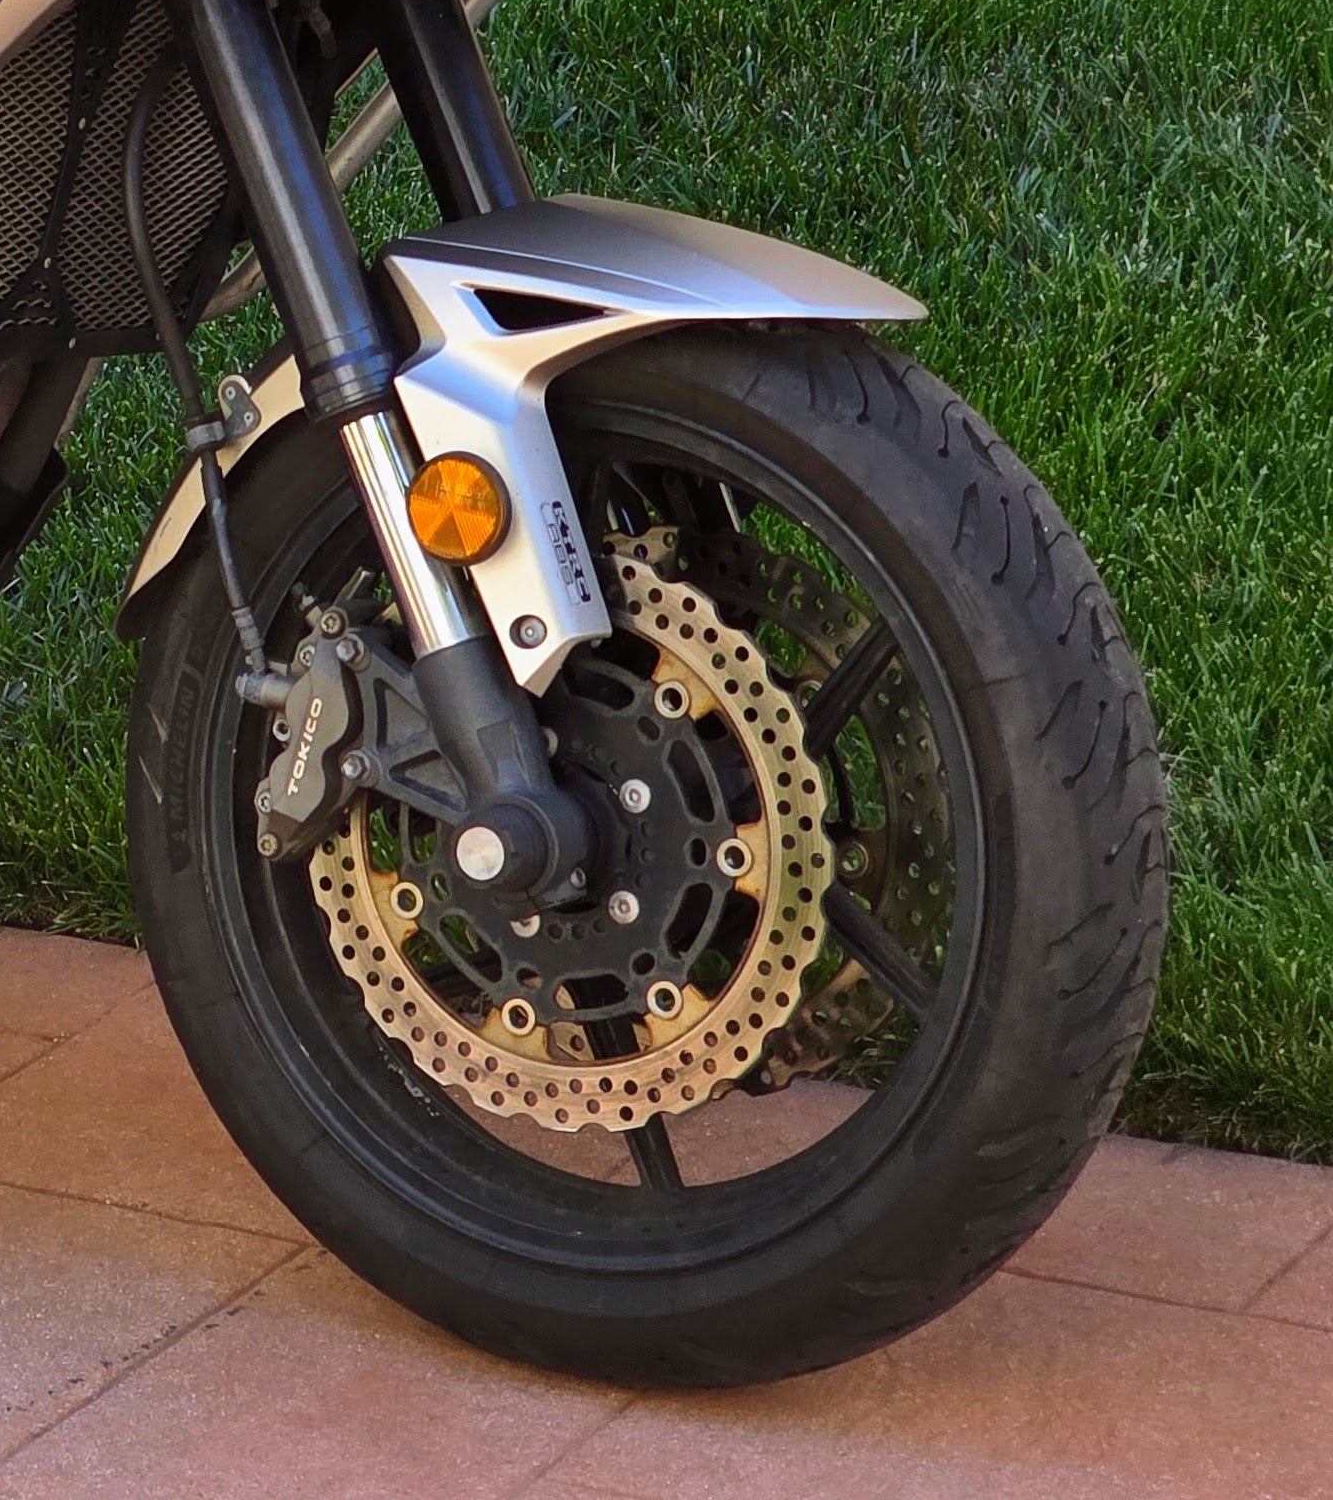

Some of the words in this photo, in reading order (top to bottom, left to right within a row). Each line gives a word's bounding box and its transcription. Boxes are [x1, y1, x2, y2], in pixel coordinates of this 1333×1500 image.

[546, 522, 574, 585] ABS
[169, 685, 195, 821] MICHELIN
[288, 698, 322, 796] TOKICO
